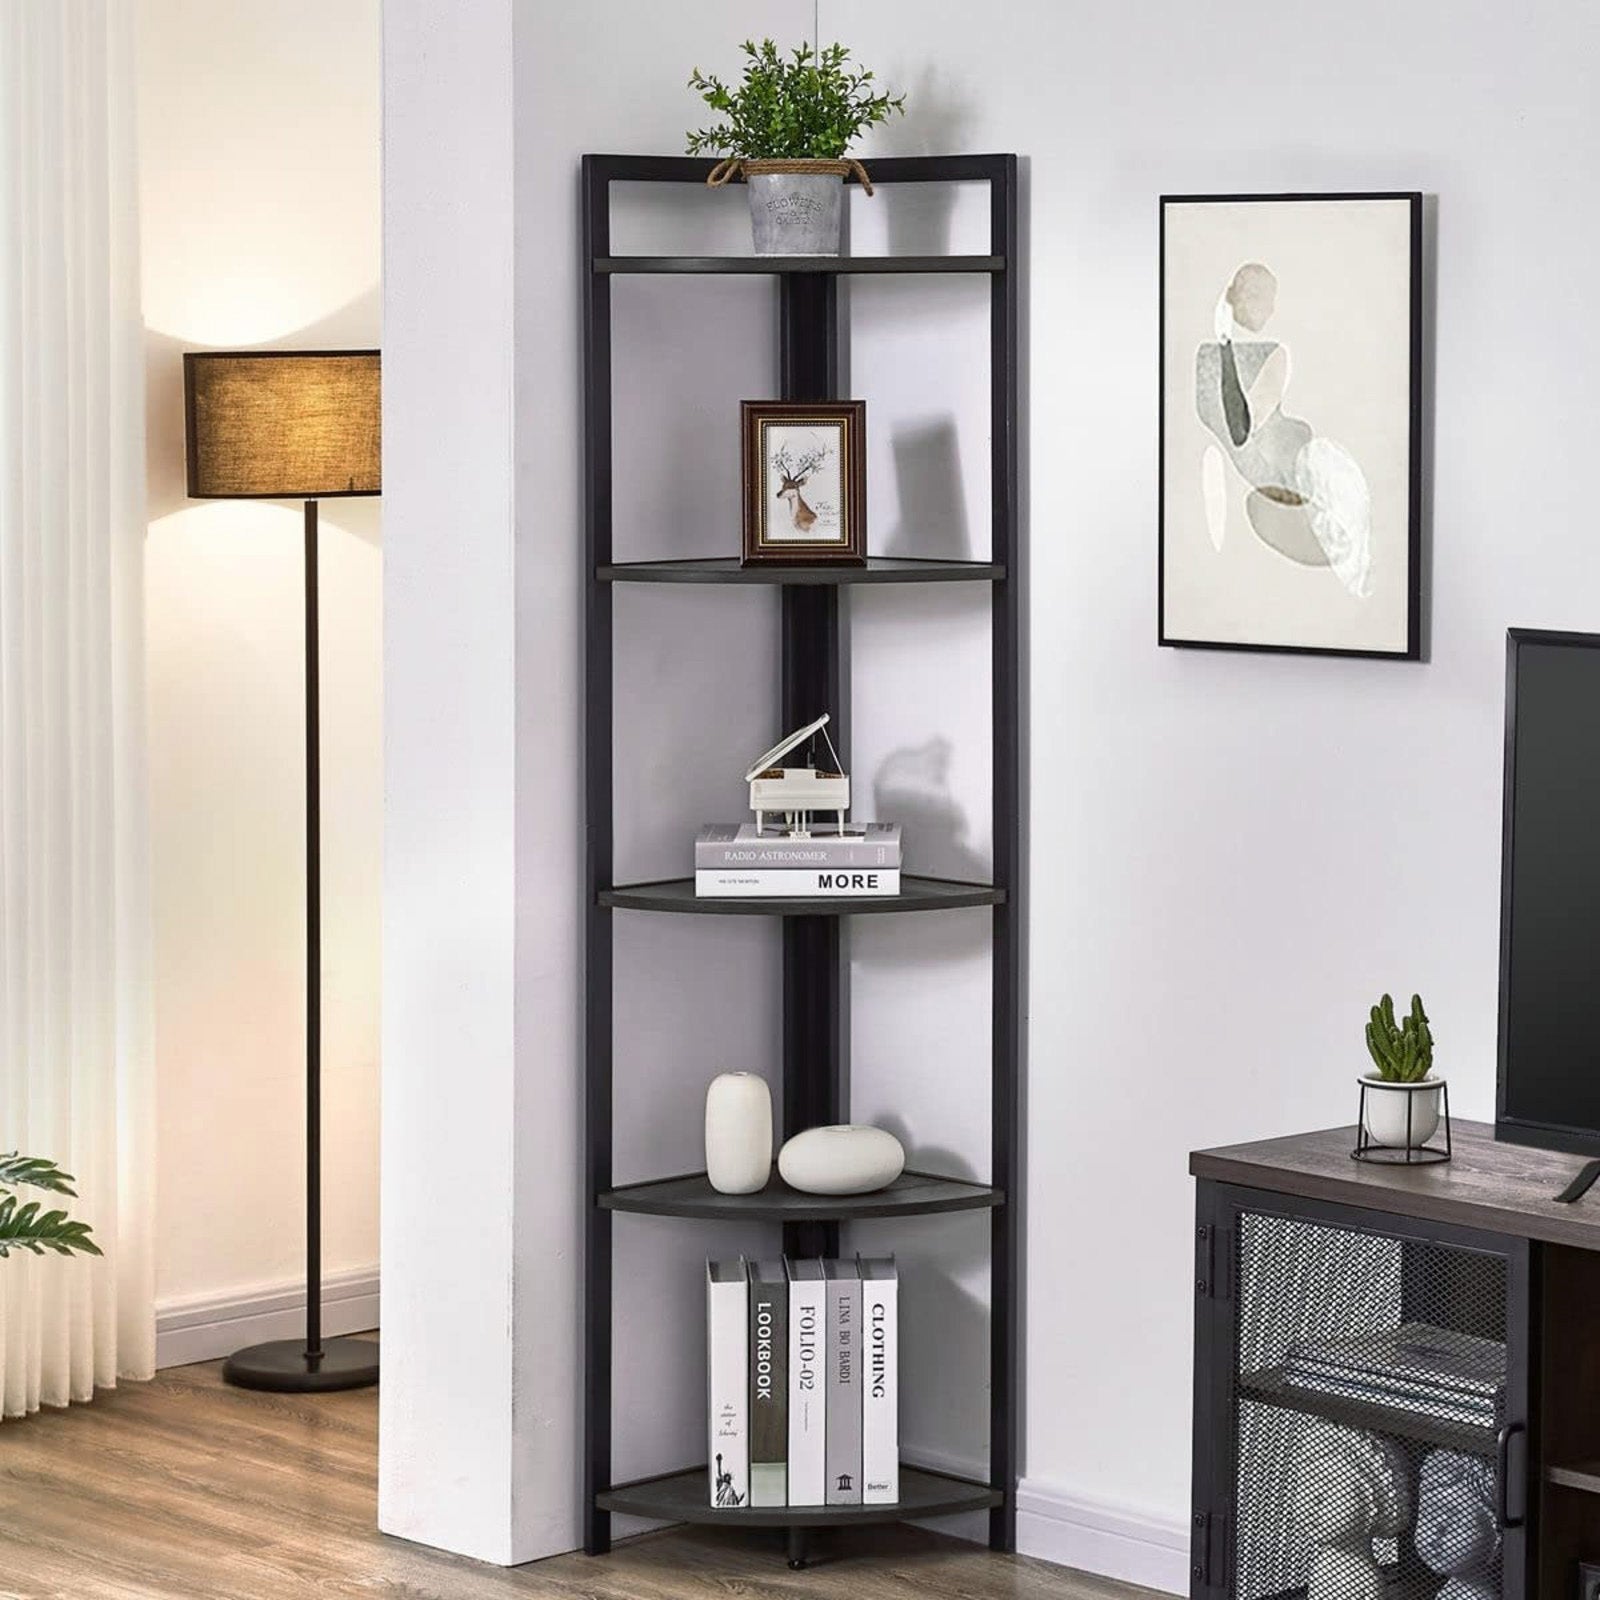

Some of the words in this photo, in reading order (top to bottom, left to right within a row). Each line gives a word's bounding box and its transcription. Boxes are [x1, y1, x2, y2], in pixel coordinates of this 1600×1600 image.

[724, 851, 756, 861] RADIO
[759, 851, 827, 861] ASTRONOMER
[818, 874, 879, 889] MORE
[838, 1296, 850, 1325] LINA
[757, 1302, 772, 1399] LOOKBOOK
[799, 1306, 815, 1391] FOLIO-02
[838, 1331, 850, 1347] BO
[872, 1303, 885, 1398] CLOTHING
[838, 1351, 851, 1384] BARDI
